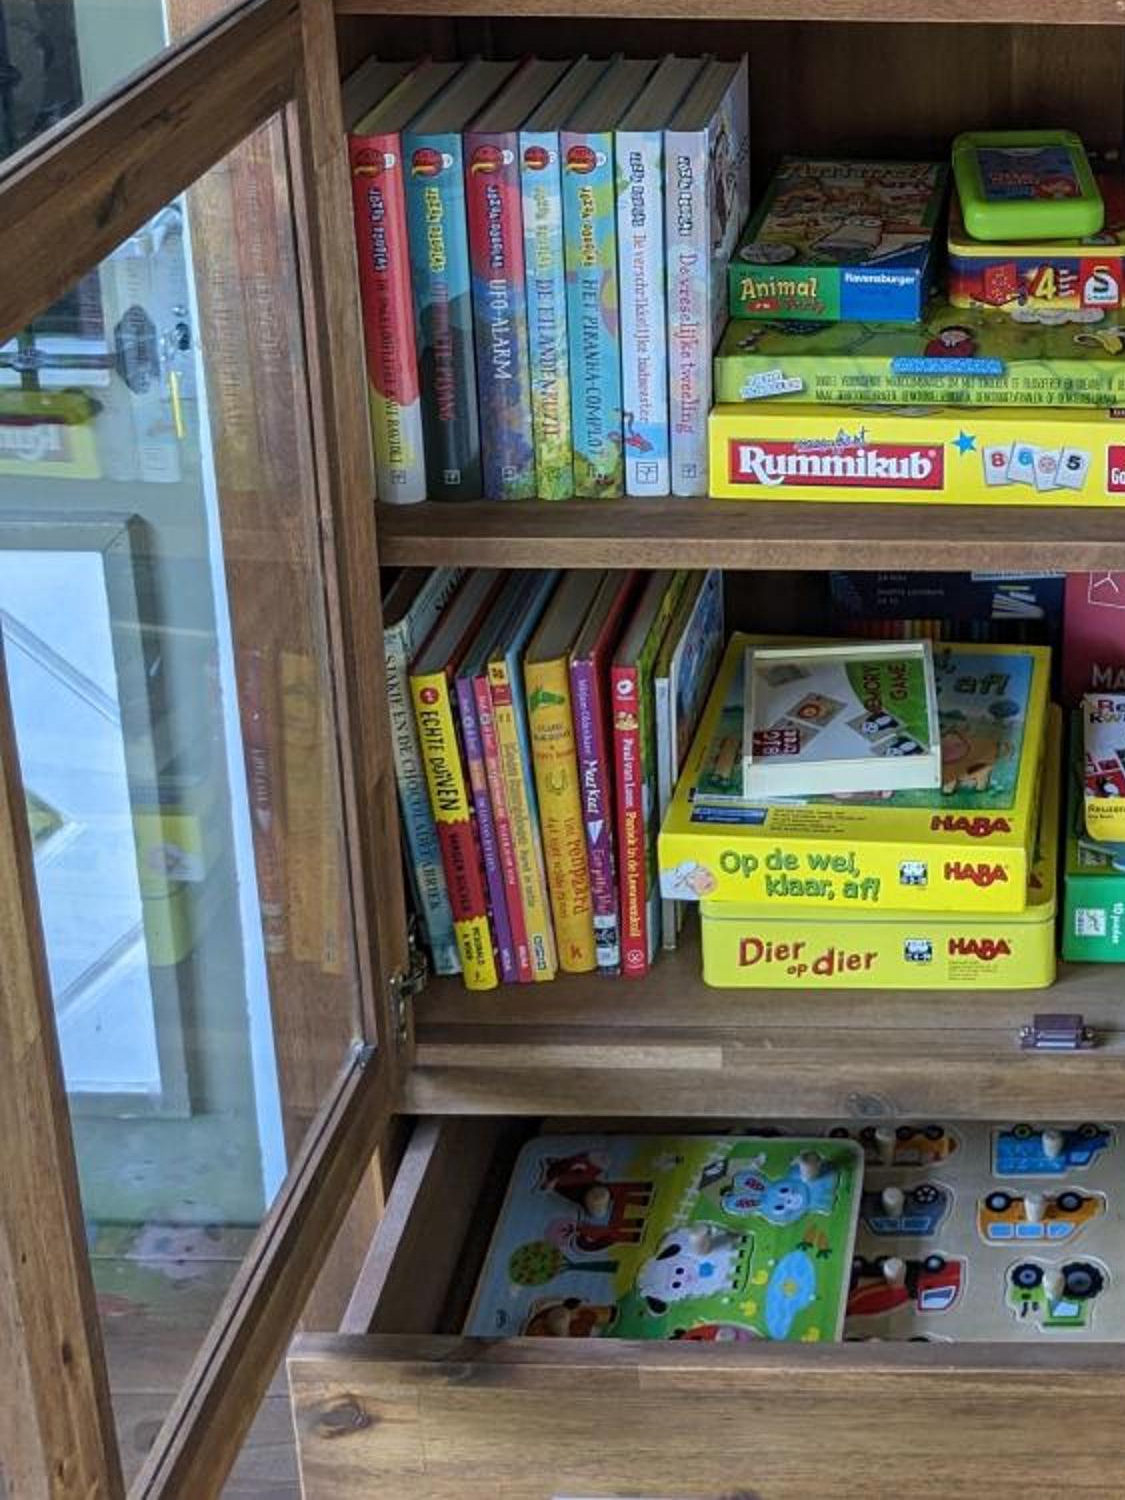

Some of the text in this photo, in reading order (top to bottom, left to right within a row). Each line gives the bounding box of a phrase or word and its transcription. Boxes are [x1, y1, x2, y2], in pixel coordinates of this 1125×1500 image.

[536, 278, 554, 299] DE
[580, 278, 599, 307] HET
[740, 275, 818, 301] Animal
[843, 271, 917, 287] Ravensburger
[490, 278, 515, 381] UFO-ALARM
[674, 253, 702, 435] De vreselijke tweeling
[736, 442, 934, 485] Rummikub
[889, 659, 910, 703] GAME
[420, 710, 444, 752] ECHTE
[621, 736, 636, 779] Paul van
[392, 710, 441, 910] EN DE CHOCOLADEFABRIEK
[931, 815, 1011, 839] HABA
[718, 846, 862, 878] Op de wei,
[943, 861, 1010, 889] HABA
[765, 874, 882, 903] klaar, af!
[738, 937, 881, 979] Dier op dier
[947, 937, 1013, 963] HABA
